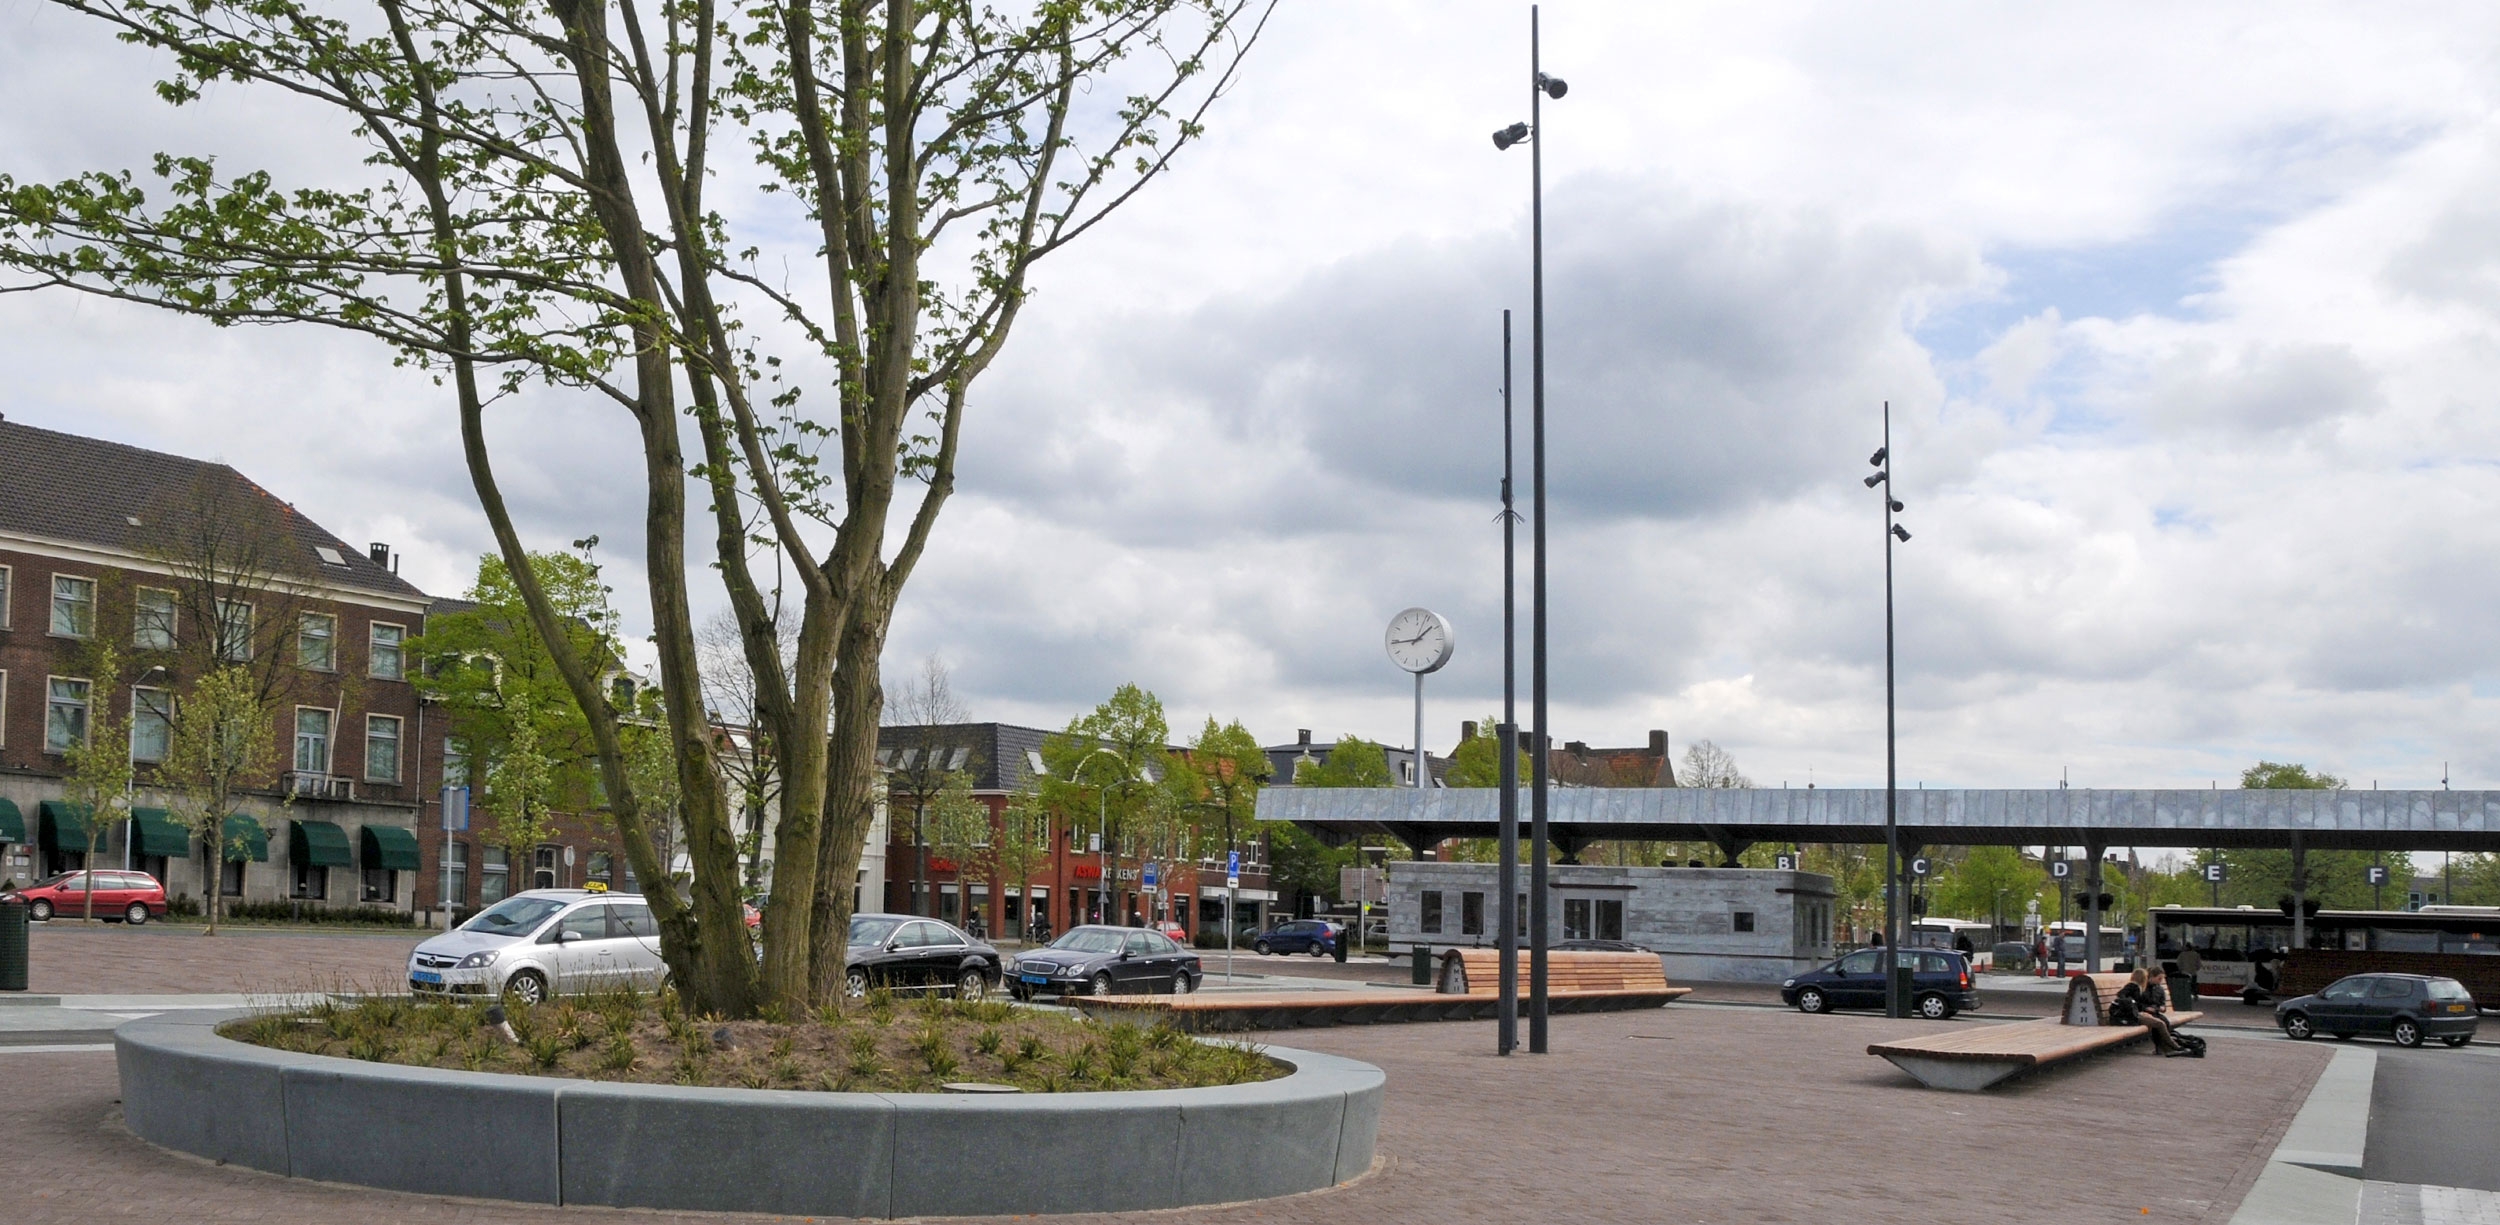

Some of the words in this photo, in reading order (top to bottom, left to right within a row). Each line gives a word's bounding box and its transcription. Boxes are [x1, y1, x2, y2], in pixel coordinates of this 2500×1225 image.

[1231, 854, 1237, 868] P
[1778, 856, 1790, 870] B
[1912, 859, 1926, 874] C
[1103, 866, 1138, 881] KEKENS
[2054, 862, 2068, 876] D
[2207, 865, 2220, 880] E
[2370, 867, 2383, 883] F
